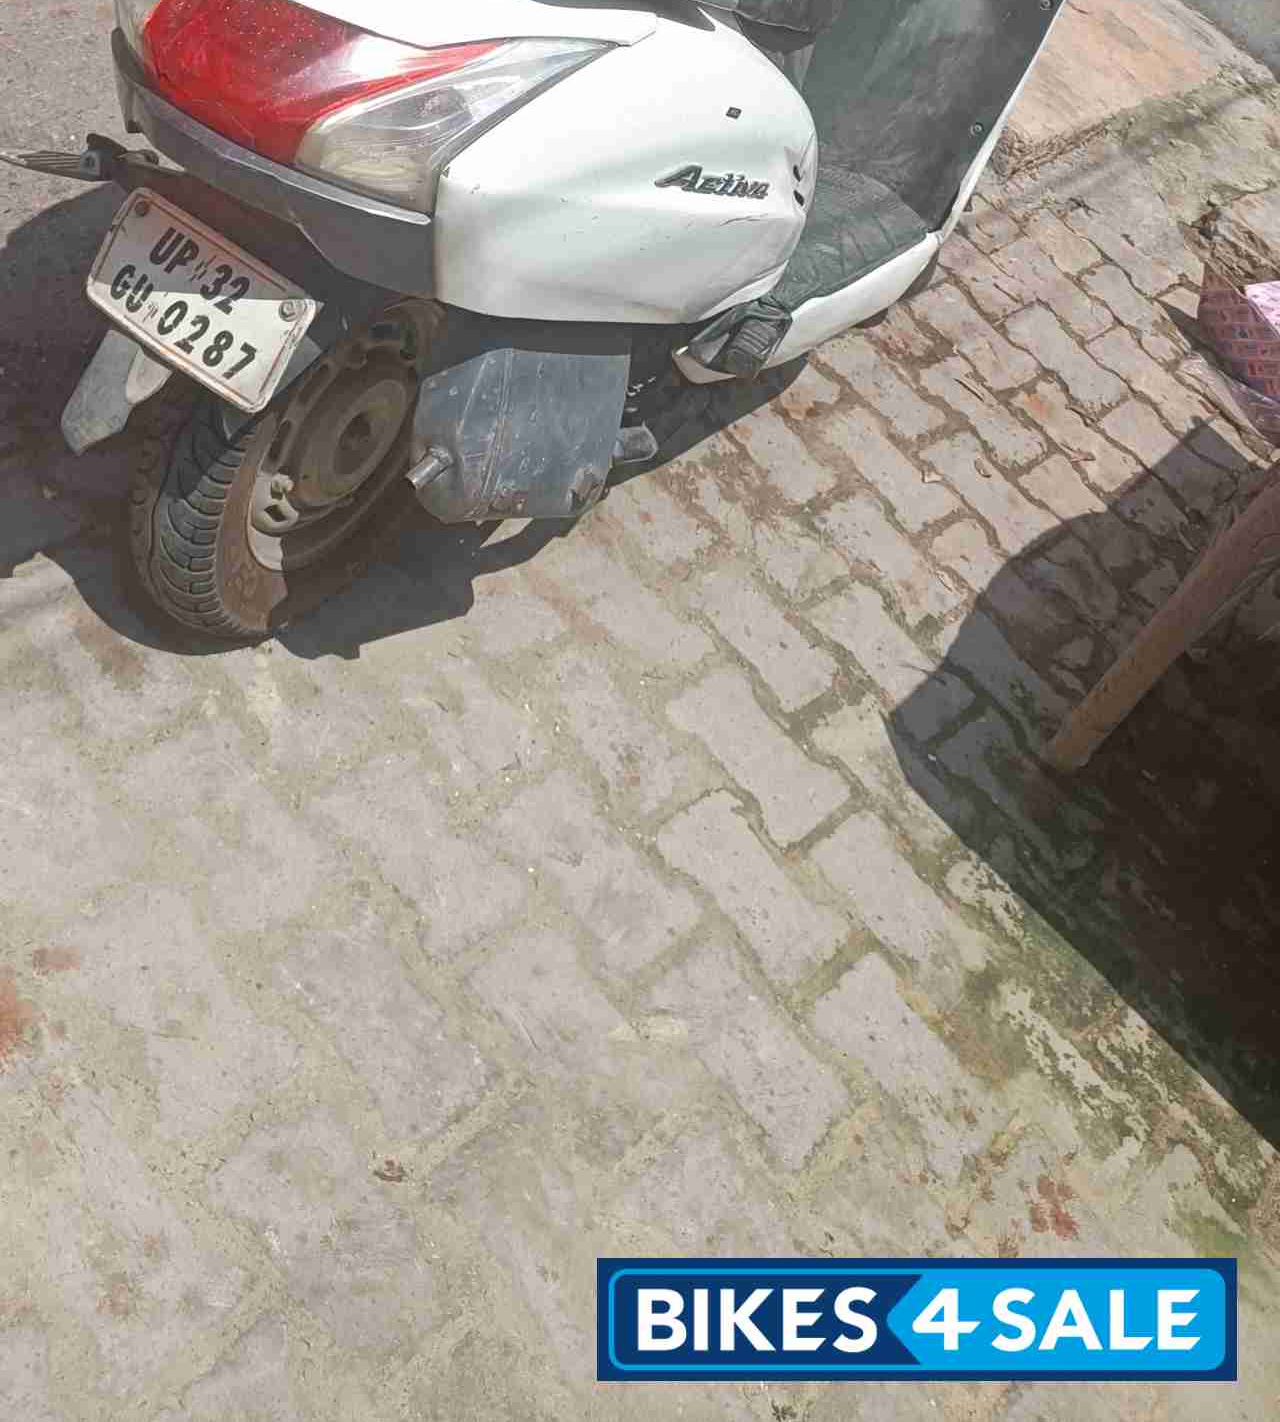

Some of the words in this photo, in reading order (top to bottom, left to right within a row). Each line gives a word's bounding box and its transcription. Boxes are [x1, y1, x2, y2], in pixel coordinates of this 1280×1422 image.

[654, 164, 770, 199] Activa
[150, 227, 199, 274] UP
[200, 265, 250, 315] 32
[110, 264, 154, 312] GU
[157, 300, 257, 379] 0287
